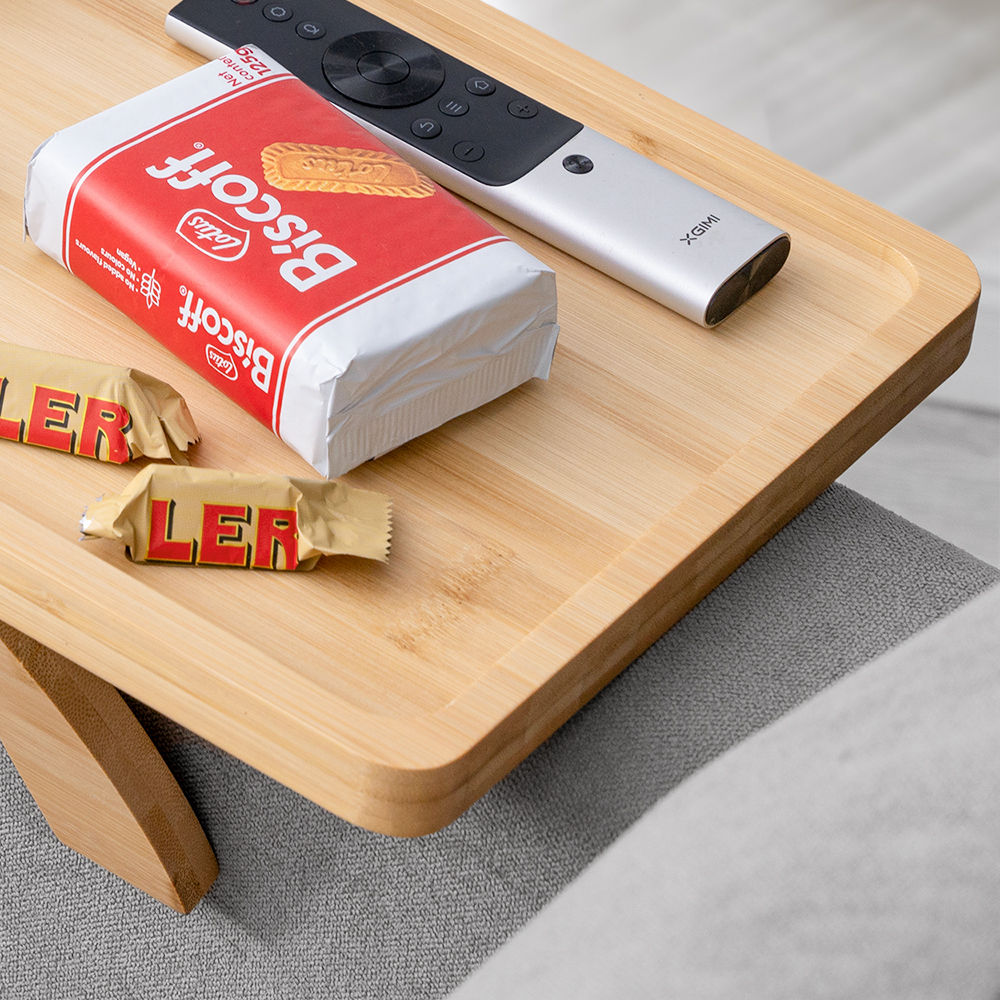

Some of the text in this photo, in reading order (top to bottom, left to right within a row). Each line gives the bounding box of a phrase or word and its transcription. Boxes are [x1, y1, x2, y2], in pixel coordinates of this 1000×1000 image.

[234, 47, 272, 76] 125g
[216, 70, 243, 88] Net
[679, 214, 721, 246] XGIMI
[75, 238, 135, 292] No added flavours
[100, 247, 136, 282] No colours
[116, 247, 137, 271] Vegan
